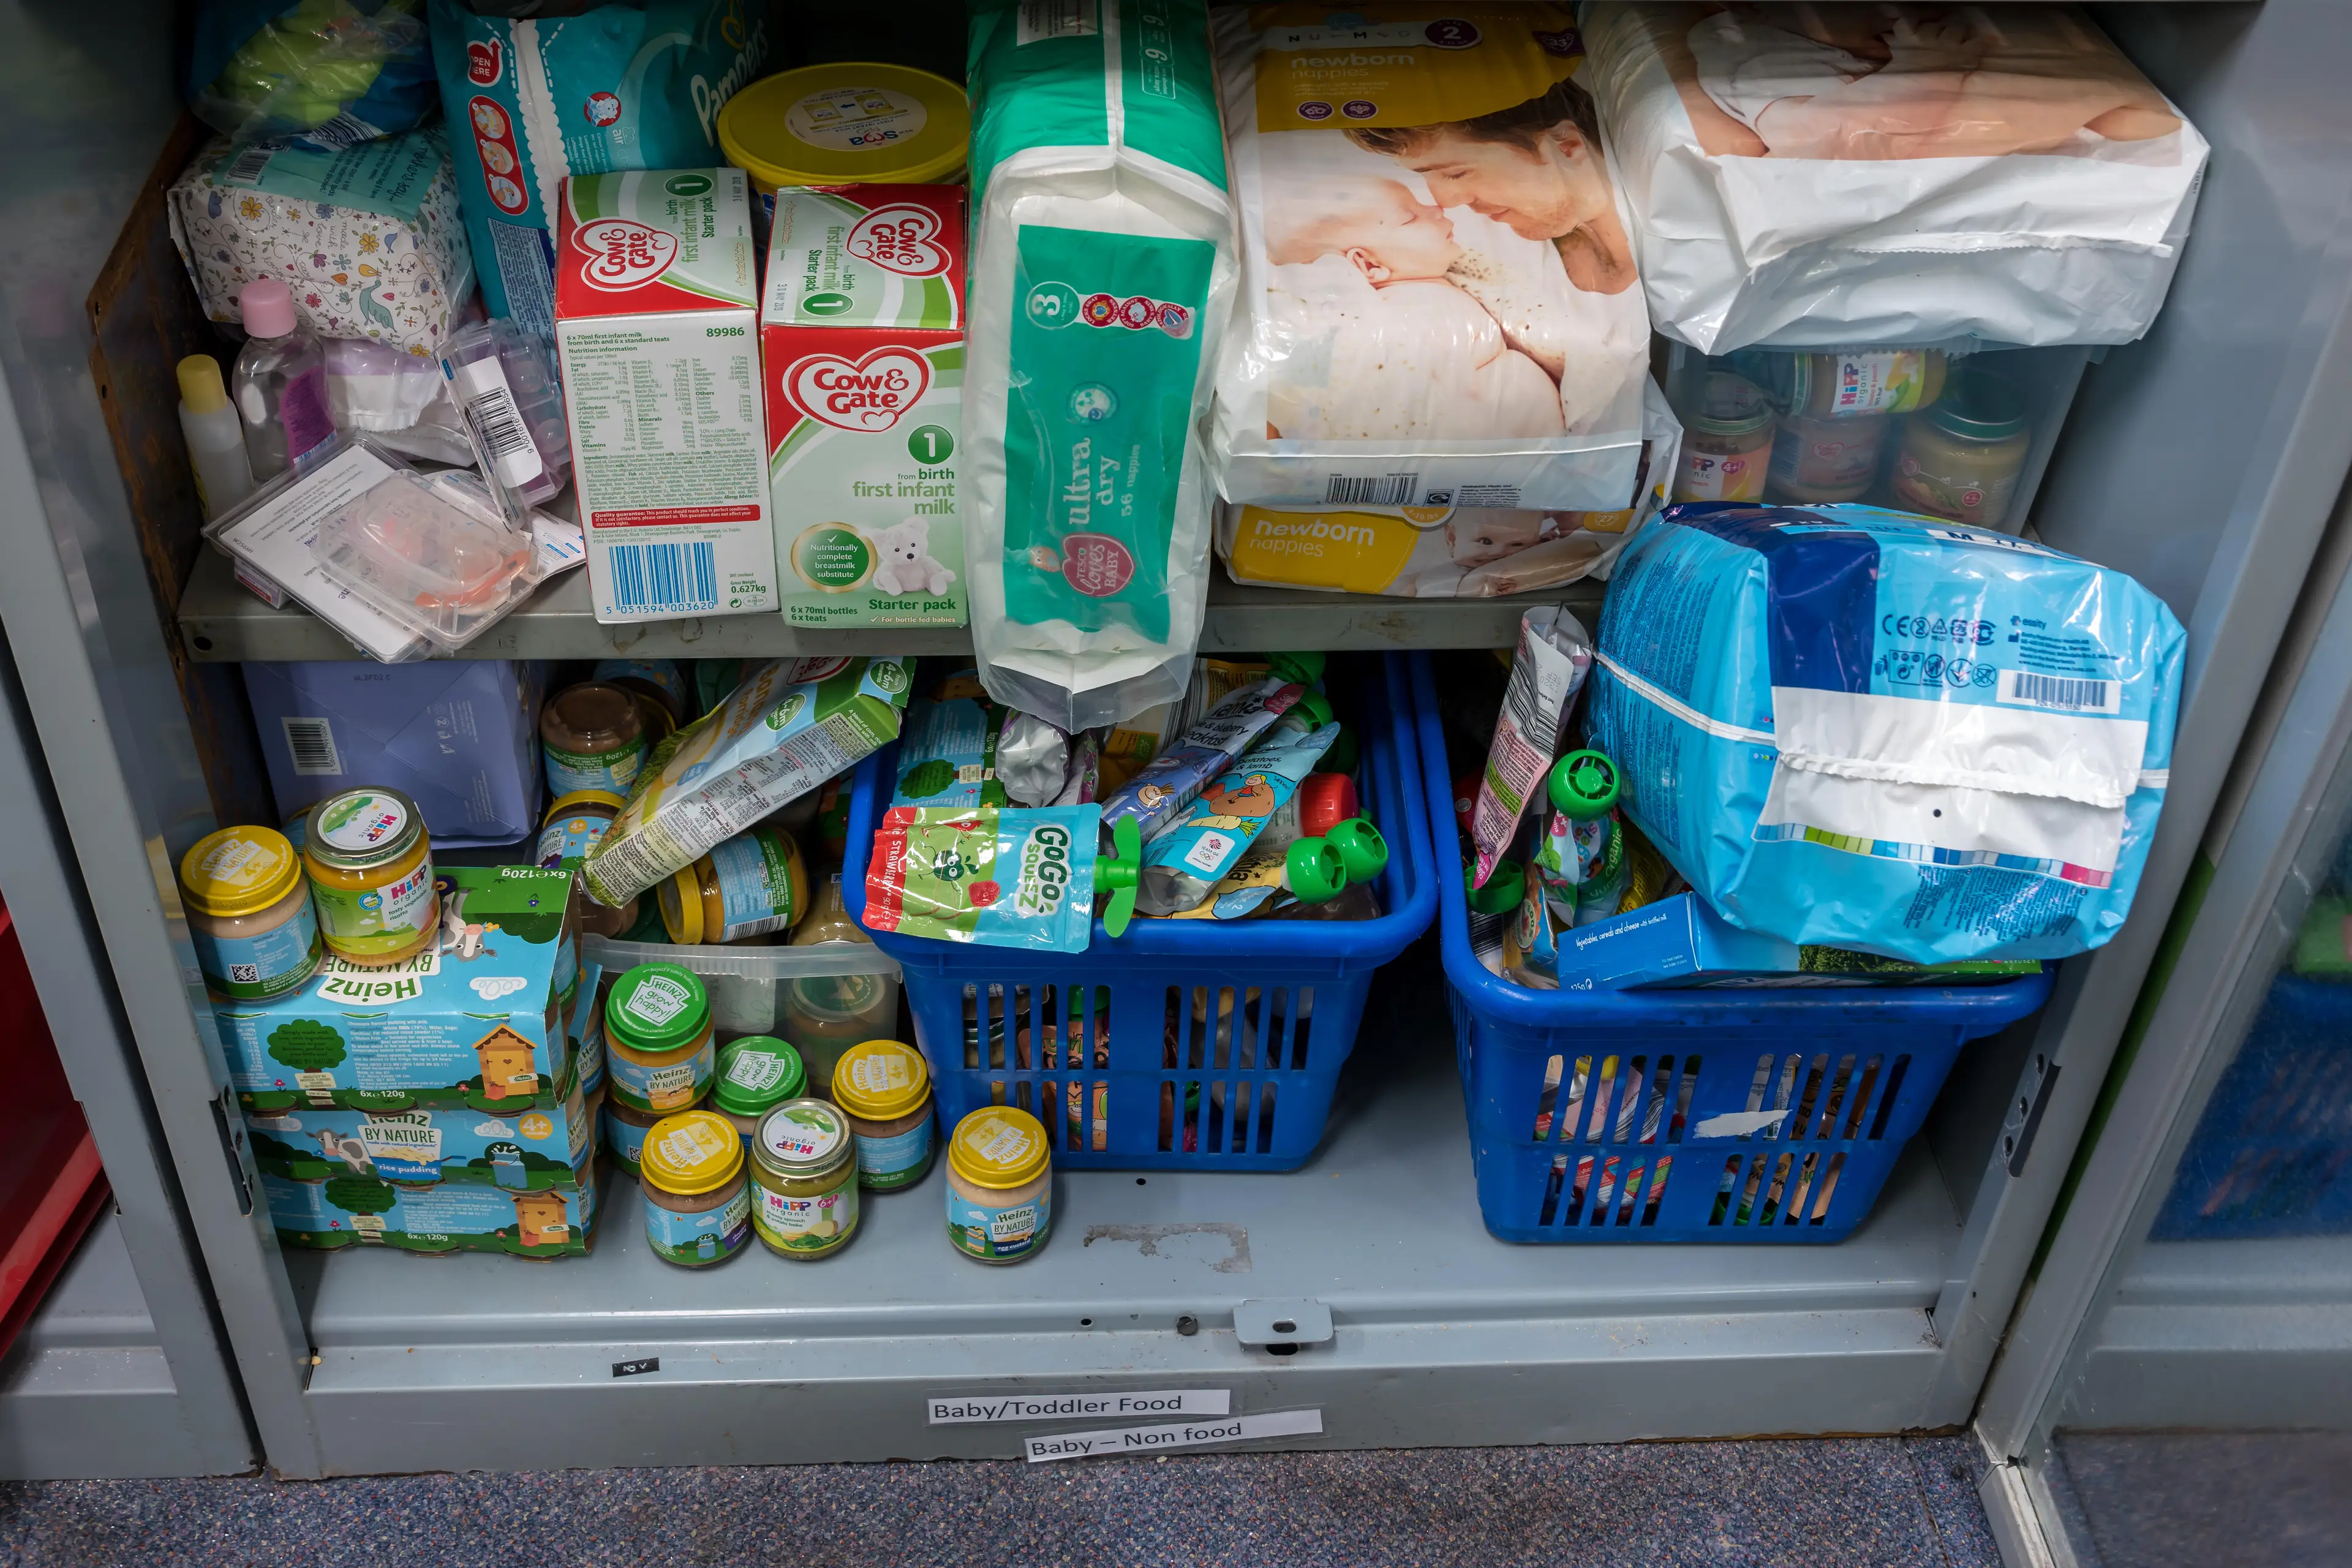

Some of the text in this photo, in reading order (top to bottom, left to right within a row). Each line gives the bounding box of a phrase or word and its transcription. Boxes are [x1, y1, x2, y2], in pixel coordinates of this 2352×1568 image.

[1442, 26, 1461, 40] 2
[1291, 53, 1415, 69] newborn
[690, 17, 769, 148] Pampers
[1291, 66, 1370, 81] nappies
[265, 195, 282, 228] tender
[316, 223, 327, 248] love
[627, 230, 656, 268] Gate
[1031, 294, 1060, 316] 3
[706, 327, 745, 337] 89986
[1840, 363, 1859, 405] HiPP
[1858, 364, 1868, 403] organic
[826, 392, 899, 414] Gate
[924, 432, 935, 458] 1
[918, 468, 955, 480] birth
[1063, 435, 1093, 526] ultra
[1095, 455, 1121, 506] dry
[1120, 443, 1140, 518] 56 nappies
[852, 481, 955, 497] first infant
[914, 499, 955, 514] milk
[1254, 517, 1376, 548] newborn
[1250, 537, 1324, 558] nappies
[1076, 547, 1087, 579] TESCO
[1082, 543, 1106, 595] loves
[1104, 549, 1119, 589] BABY
[731, 584, 766, 594] 0.627kg
[621, 605, 665, 614] 051594
[671, 601, 714, 612] 003620
[869, 598, 956, 612] Starter pack
[848, 715, 862, 731] banana
[852, 712, 864, 723] blend
[358, 812, 384, 838] organic
[367, 814, 398, 842] HiPP
[391, 864, 427, 900] HiPP
[1019, 843, 1041, 909] SQUEEZ
[393, 878, 428, 905] organic
[388, 889, 427, 916] tasty vegetable
[390, 910, 408, 921] risotto
[1599, 929, 1614, 940] cereals
[1615, 923, 1624, 935] and
[1624, 921, 1640, 933] cheese
[325, 978, 417, 1002] Heinz
[645, 990, 674, 1006] grow
[655, 981, 682, 1000] HEINZ
[635, 996, 671, 1018] happy!
[650, 1073, 693, 1089] BY NATURE
[652, 1067, 690, 1080] Heinz
[857, 1060, 867, 1090] Heinz
[522, 1118, 547, 1131] 4+
[365, 1128, 436, 1143] BY NATURE
[781, 1135, 815, 1145] organic
[775, 1140, 814, 1155] HiPP
[998, 1137, 1030, 1163] Heinz
[398, 1165, 437, 1175] pudding
[770, 1195, 812, 1212] HiPP
[771, 1206, 810, 1217] organic
[767, 1210, 782, 1220] cheesy
[771, 1216, 788, 1227] potato
[998, 1209, 1033, 1223] Heinz
[1006, 1216, 1035, 1231] NATURE
[1009, 1239, 1030, 1249] custard
[934, 1395, 1182, 1420] Baby/Toddler Food
[1031, 1422, 1242, 1457] Baby Non food
